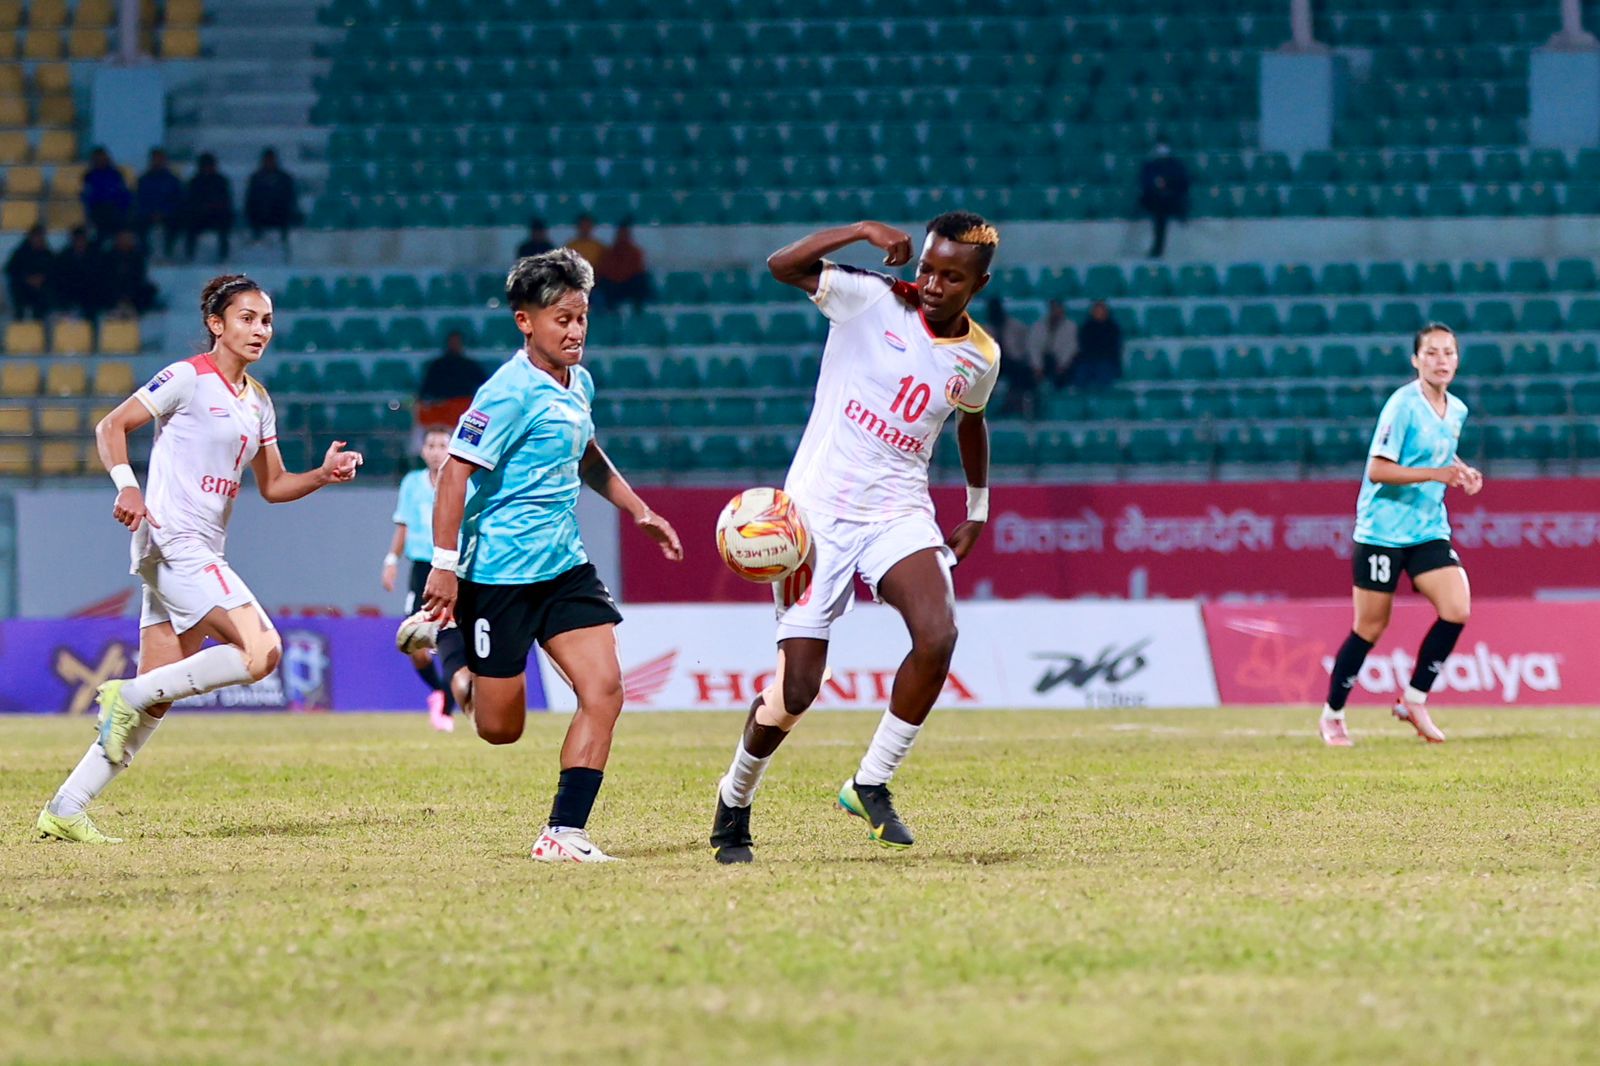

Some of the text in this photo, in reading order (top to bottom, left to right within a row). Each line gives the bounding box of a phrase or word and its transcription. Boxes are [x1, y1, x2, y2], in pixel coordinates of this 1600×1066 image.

[889, 375, 931, 424] 10
[233, 434, 249, 471] 7
[745, 545, 788, 559] KELME
[1367, 554, 1391, 584] 13
[204, 563, 231, 596] 7
[784, 563, 813, 608] 10
[474, 618, 491, 659] 6
[1321, 641, 1562, 703] atalya
